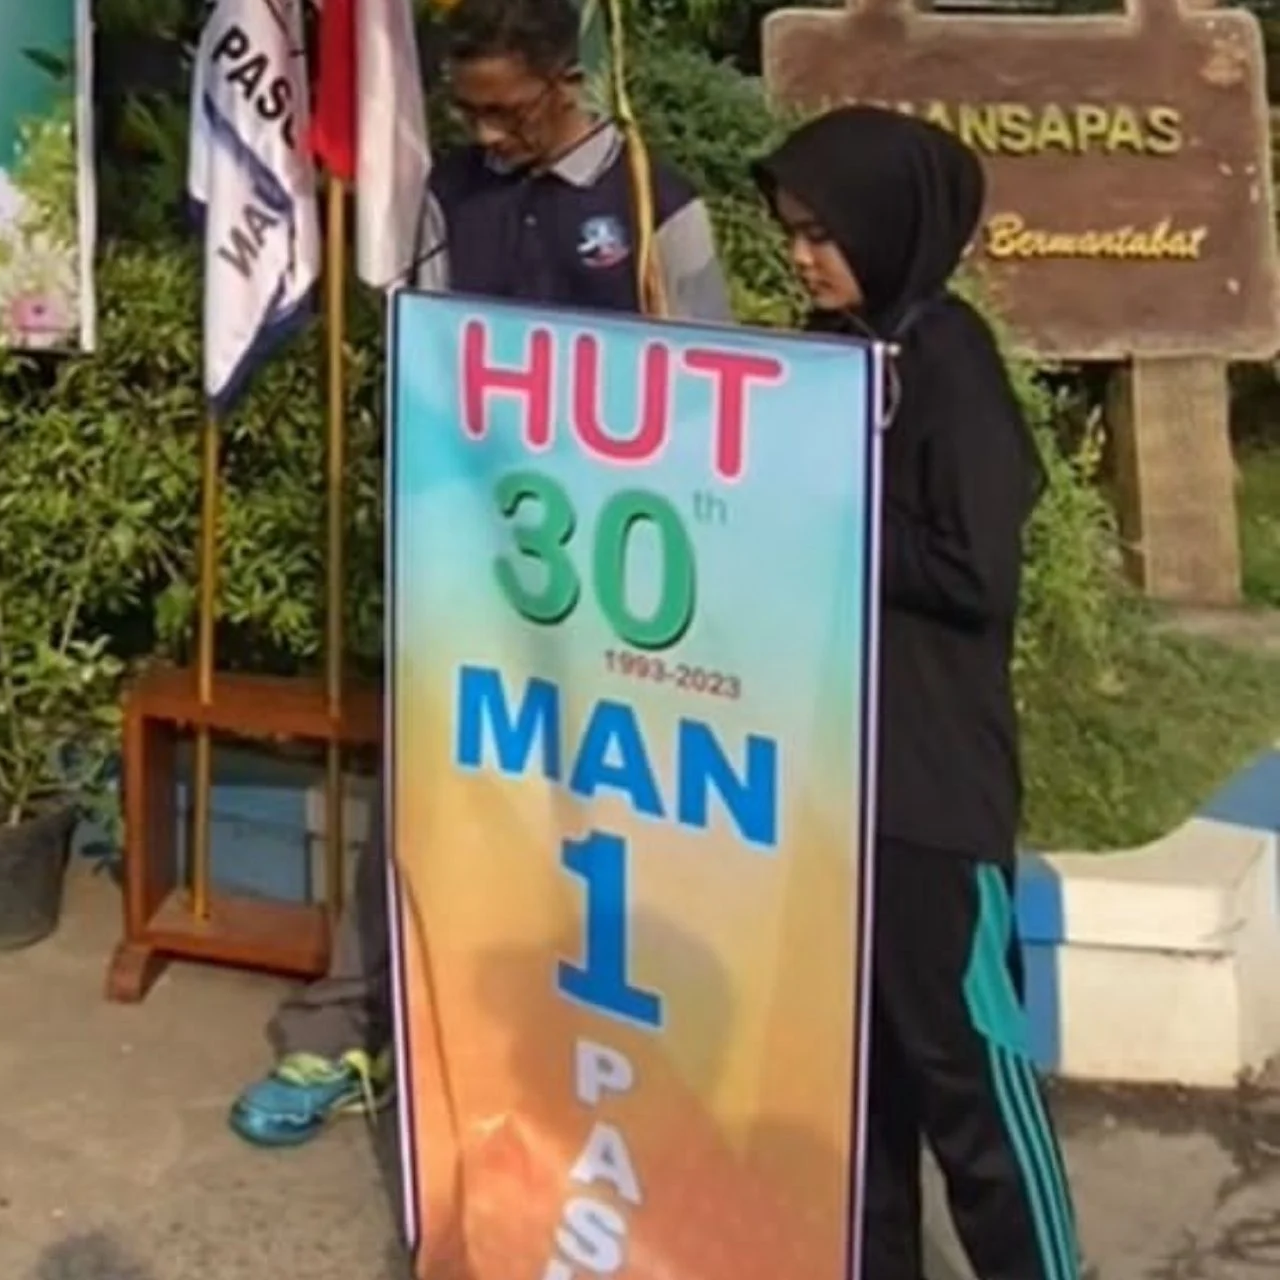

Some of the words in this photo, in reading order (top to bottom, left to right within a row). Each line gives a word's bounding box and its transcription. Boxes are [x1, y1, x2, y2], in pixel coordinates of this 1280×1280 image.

[459, 317, 788, 482] HUT
[456, 664, 779, 848] MAN
[603, 648, 742, 701] 1993-2023
[556, 829, 664, 1028] 1
